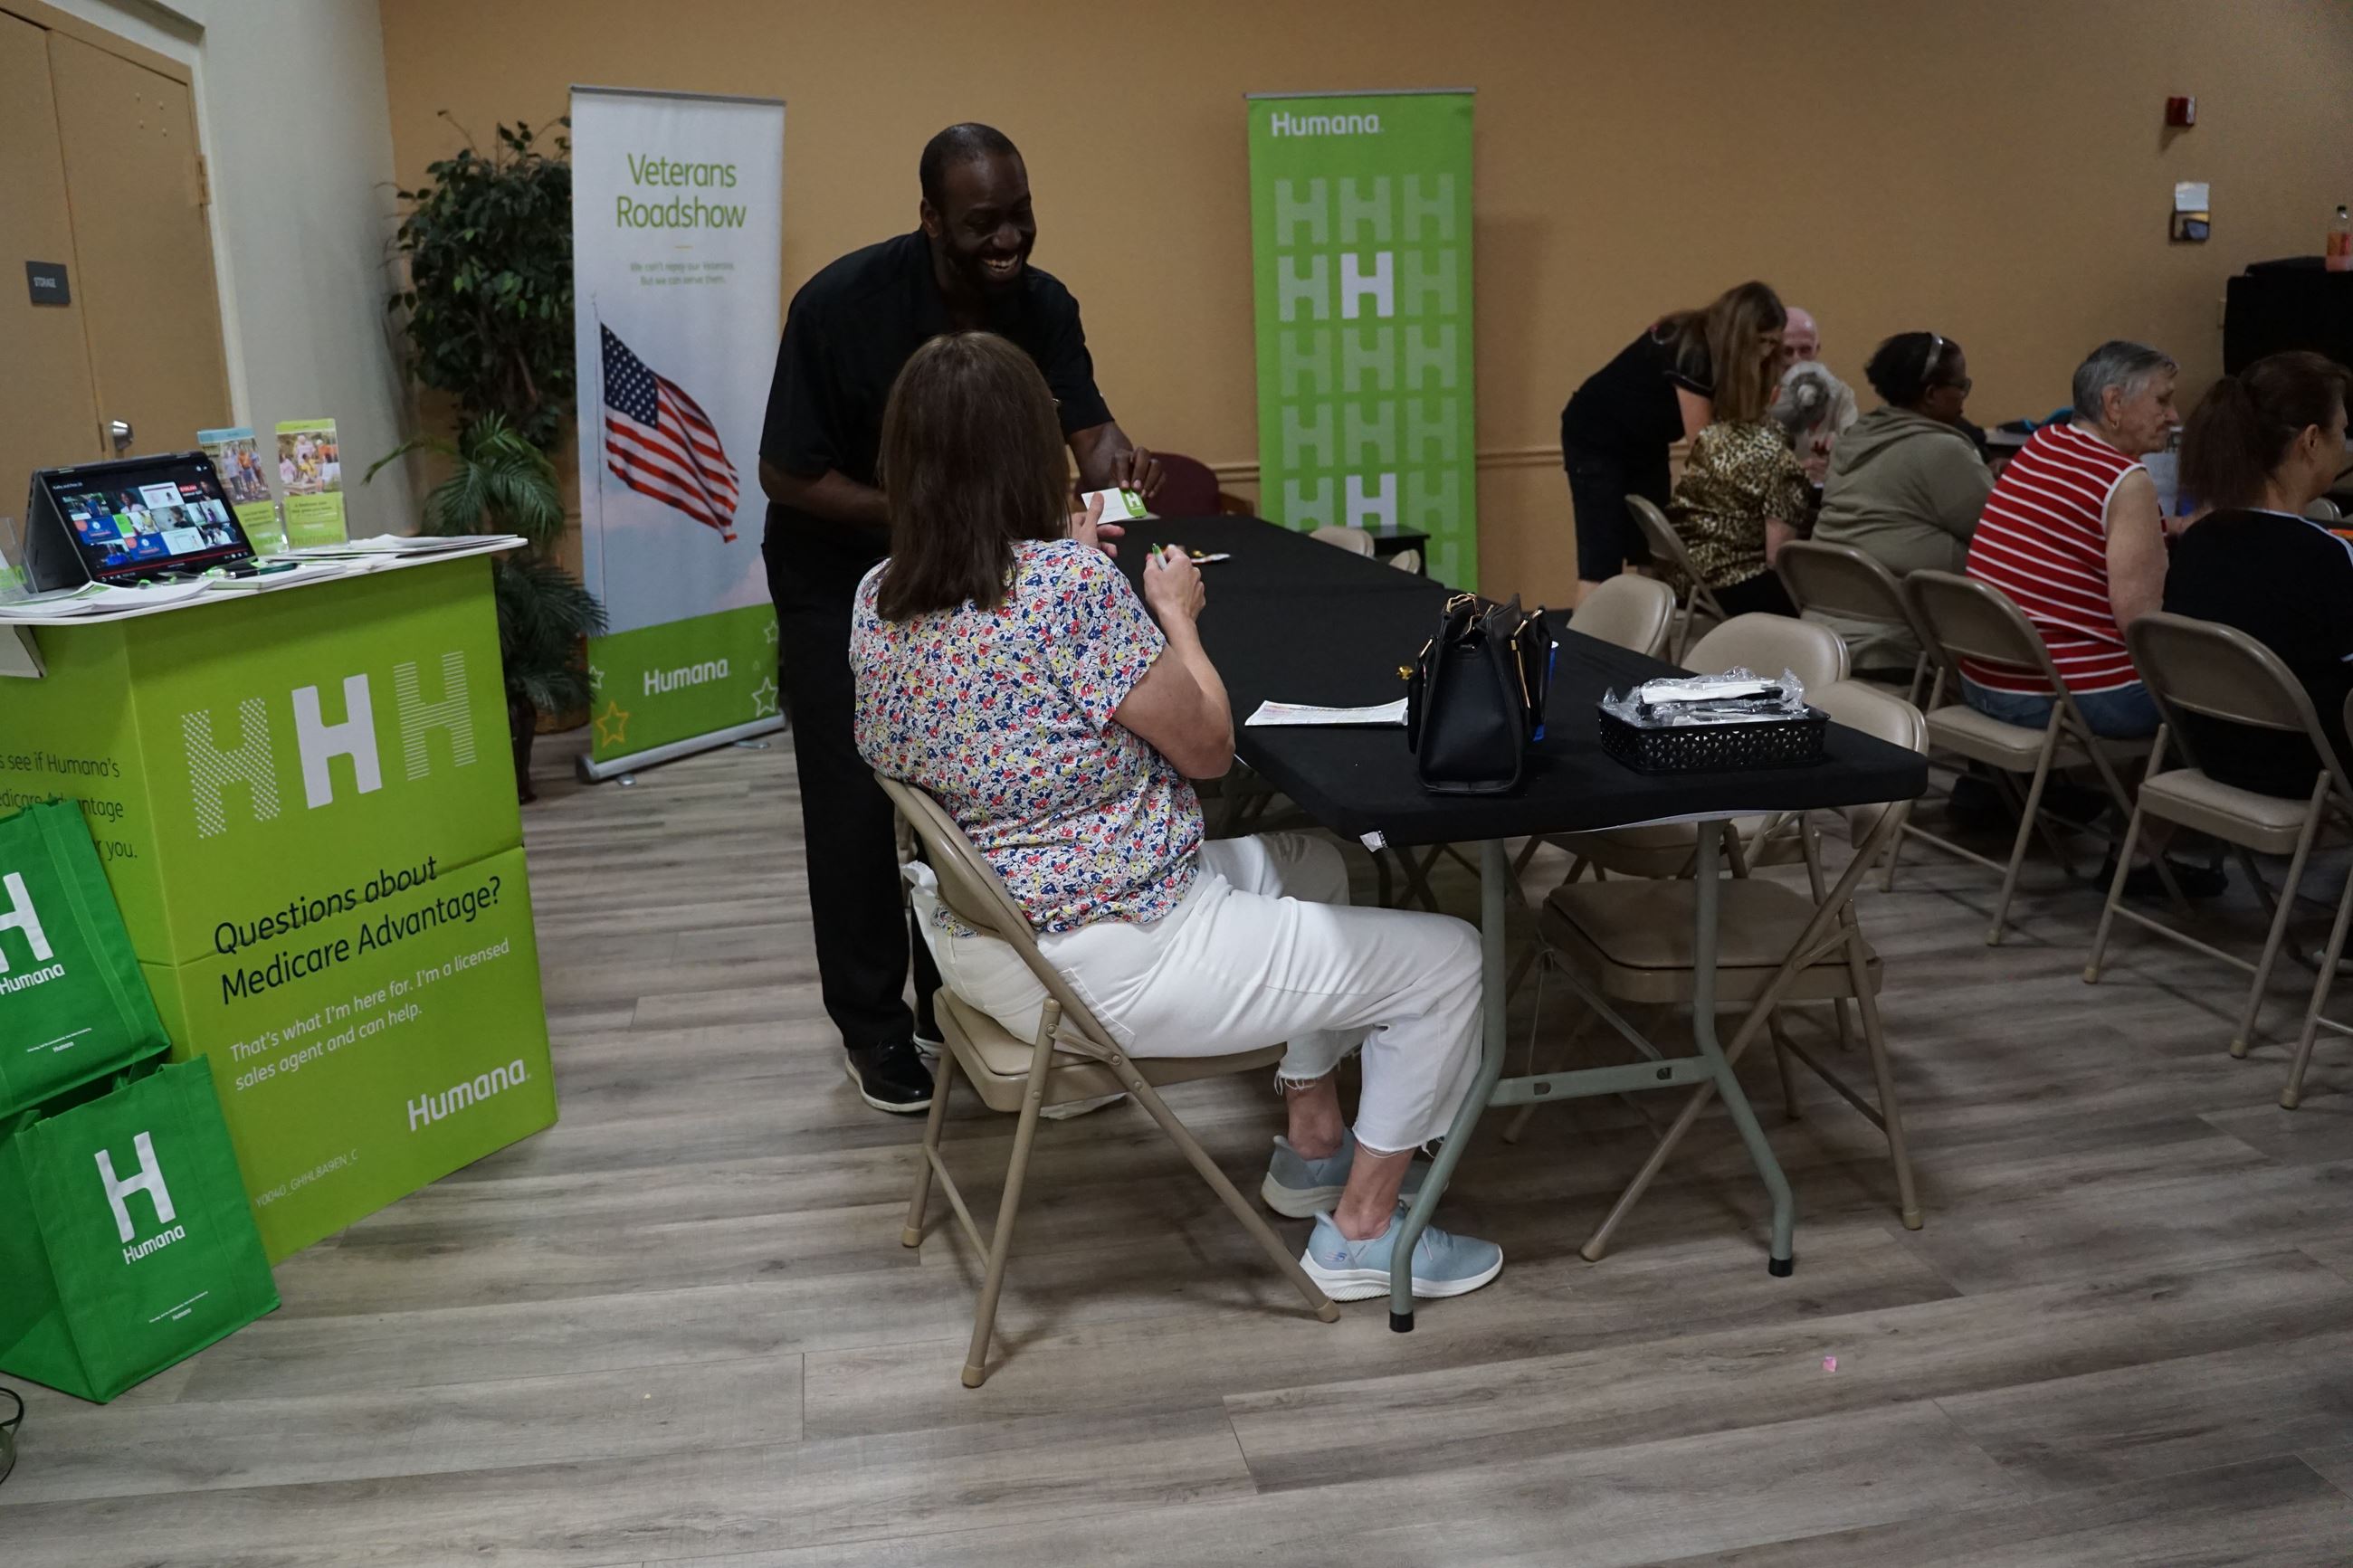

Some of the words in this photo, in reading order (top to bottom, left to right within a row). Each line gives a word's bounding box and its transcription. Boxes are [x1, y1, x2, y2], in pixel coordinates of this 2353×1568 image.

[1272, 111, 1379, 138] Humana
[627, 152, 737, 188] Veterans
[616, 195, 748, 229] Roadshow
[1340, 251, 1395, 318] H
[643, 658, 729, 697] Humana
[7, 755, 32, 772] see
[34, 751, 43, 772] if
[46, 753, 120, 778] Humana's
[181, 697, 281, 840] H
[291, 673, 383, 810] H
[393, 651, 477, 782] H
[106, 841, 138, 861] you.
[214, 889, 357, 955] Questions
[364, 856, 438, 903] about
[221, 939, 349, 1005] Medicare
[357, 876, 501, 955] Advantage?
[0, 963, 66, 995] Humana
[230, 1028, 280, 1062] That's
[282, 1013, 322, 1041] what
[325, 1003, 351, 1025] I'm
[354, 988, 386, 1012] here
[390, 977, 414, 999] for.
[416, 966, 440, 989] I'm
[443, 961, 452, 976] a
[454, 937, 510, 972] licensed
[235, 1061, 276, 1091] sales
[279, 1041, 324, 1073] agent
[327, 1025, 356, 1051] and
[358, 1016, 386, 1038] can
[387, 1002, 423, 1026] help.
[406, 1059, 528, 1132] Humana
[94, 1131, 176, 1244] H
[122, 1224, 186, 1266] Humana
